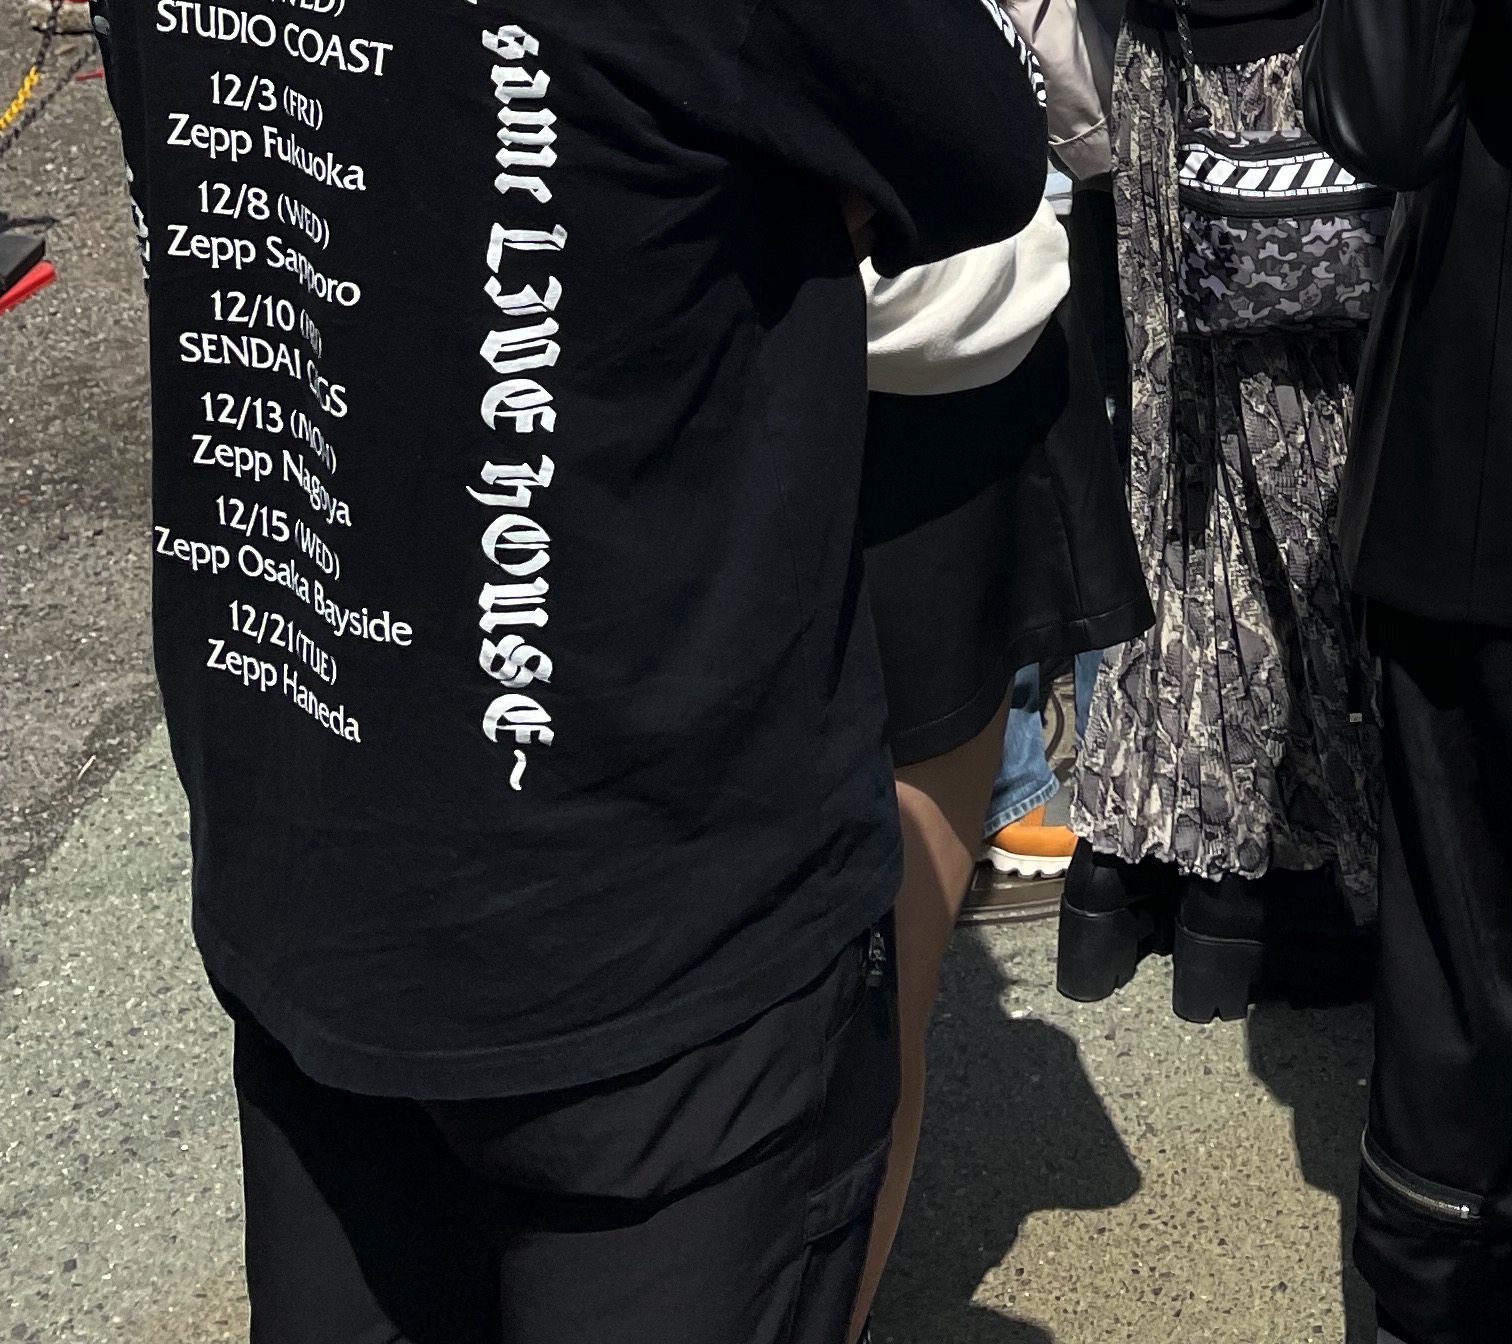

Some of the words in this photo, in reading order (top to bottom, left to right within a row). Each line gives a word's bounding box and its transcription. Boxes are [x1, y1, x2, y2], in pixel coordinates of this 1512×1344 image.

[283, 22, 394, 77] COAST
[209, 70, 278, 112] 12/3
[283, 84, 324, 131] (FRI)
[482, 24, 558, 203] same
[166, 112, 253, 163] Zepp
[262, 124, 367, 192] Fukuoka
[198, 180, 270, 221] 12/8
[277, 192, 331, 251] (WED)
[166, 224, 256, 270] Zepp
[265, 235, 361, 306] Sapporo
[210, 289, 295, 333] 12/10
[178, 331, 301, 380] SENDAI
[200, 391, 285, 435] 12/13
[191, 434, 273, 483] Zepp
[282, 449, 352, 527] Nagoya
[215, 495, 291, 542] 12/15
[294, 518, 340, 581] (WED)
[154, 525, 230, 574] Zepp
[238, 544, 311, 605] Osaka
[314, 579, 413, 647] Bayside
[228, 600, 294, 653] 12/21
[206, 638, 278, 692] Zepp
[283, 663, 362, 744] Haneda
